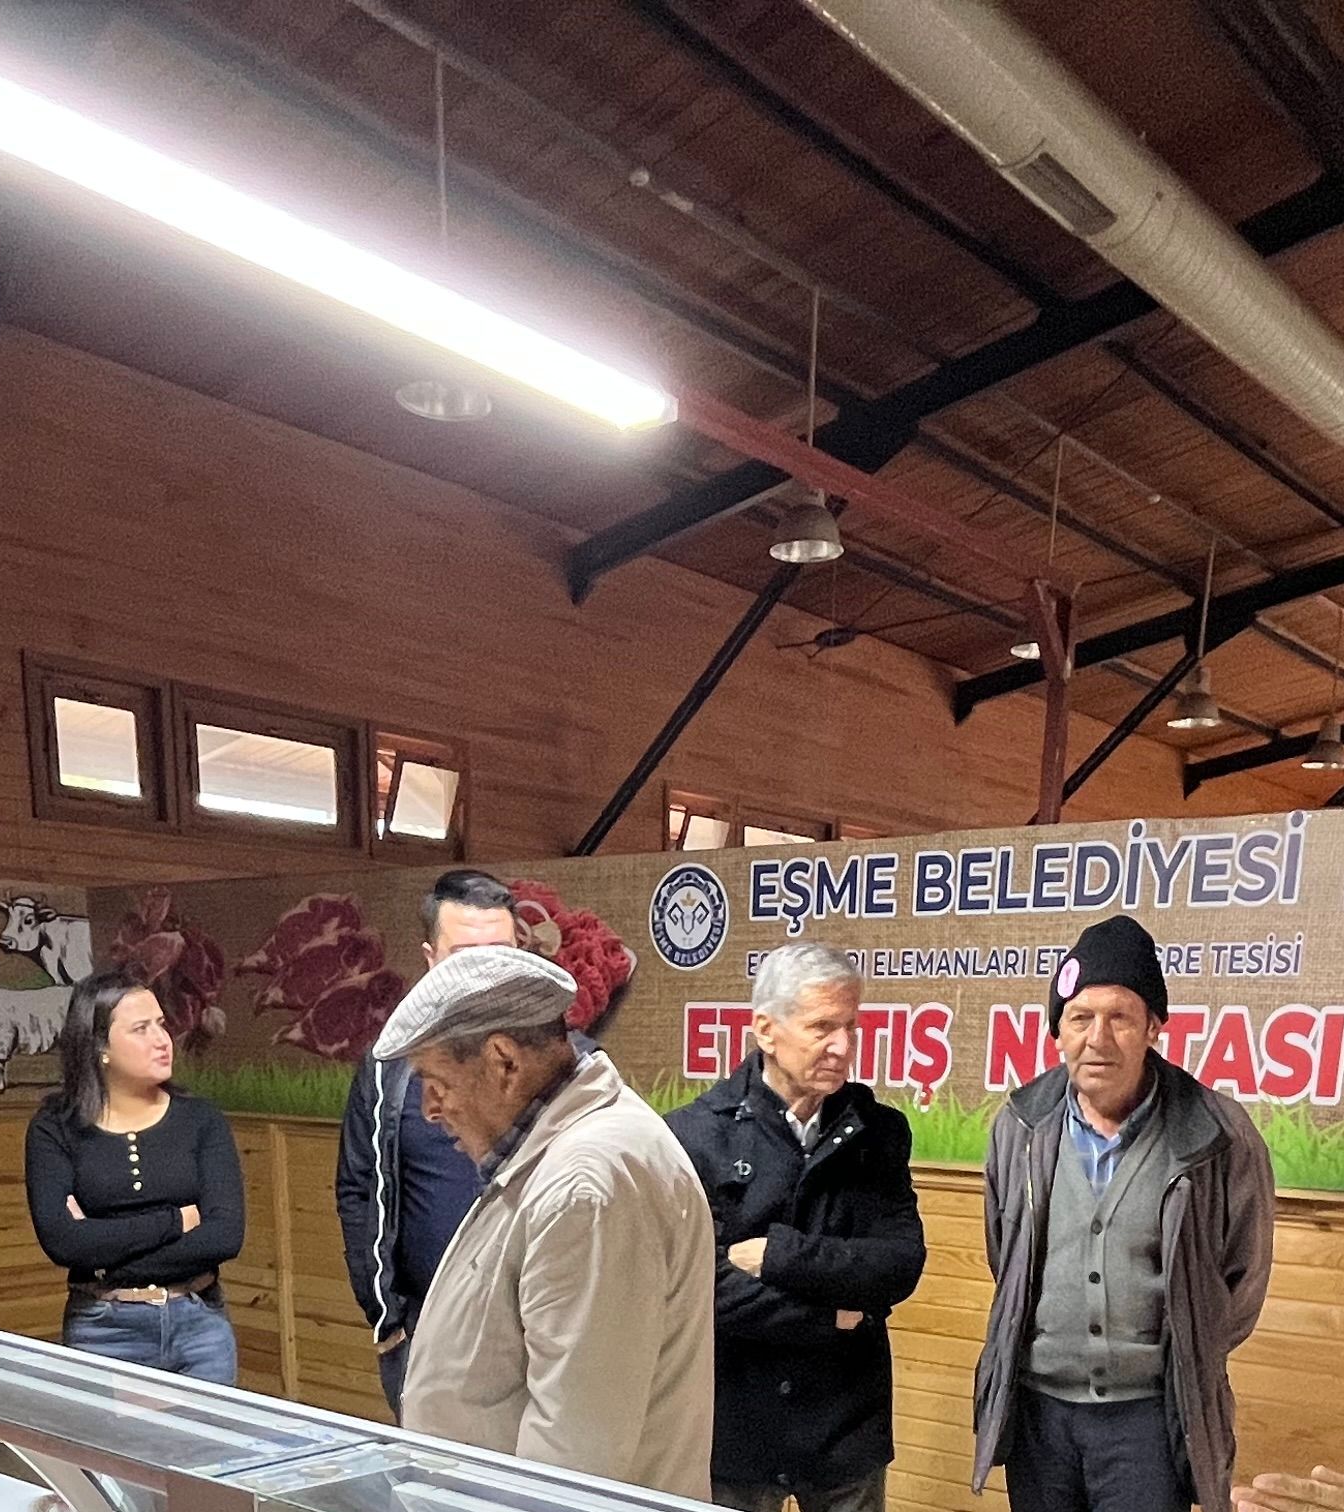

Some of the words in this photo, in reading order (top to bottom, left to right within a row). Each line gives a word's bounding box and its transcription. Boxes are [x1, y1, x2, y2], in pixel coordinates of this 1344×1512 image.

[749, 853, 899, 937] EŞME
[912, 811, 1307, 916] BELEDİYESİ
[872, 946, 1027, 978] ELEMANLARI
[1211, 932, 1305, 977] TESİSİ
[856, 1002, 955, 1107] TIŞ
